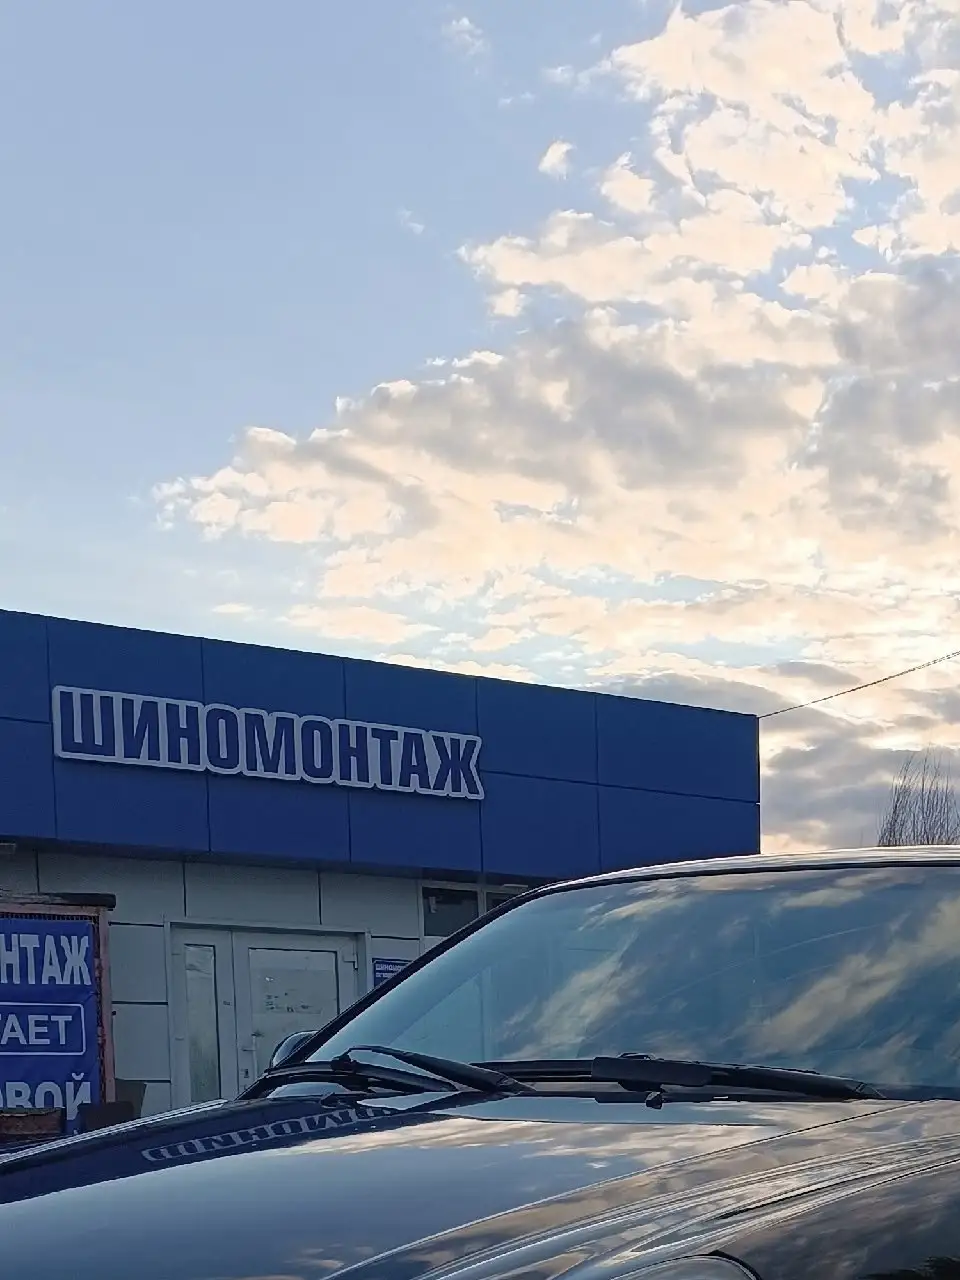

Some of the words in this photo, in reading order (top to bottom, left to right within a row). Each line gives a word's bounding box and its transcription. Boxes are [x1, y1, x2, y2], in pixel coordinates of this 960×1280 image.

[53, 687, 483, 798] ШИНОМОНТАЖ
[0, 1013, 73, 1045] АЕТ
[0, 1072, 92, 1120] ВОЙ
